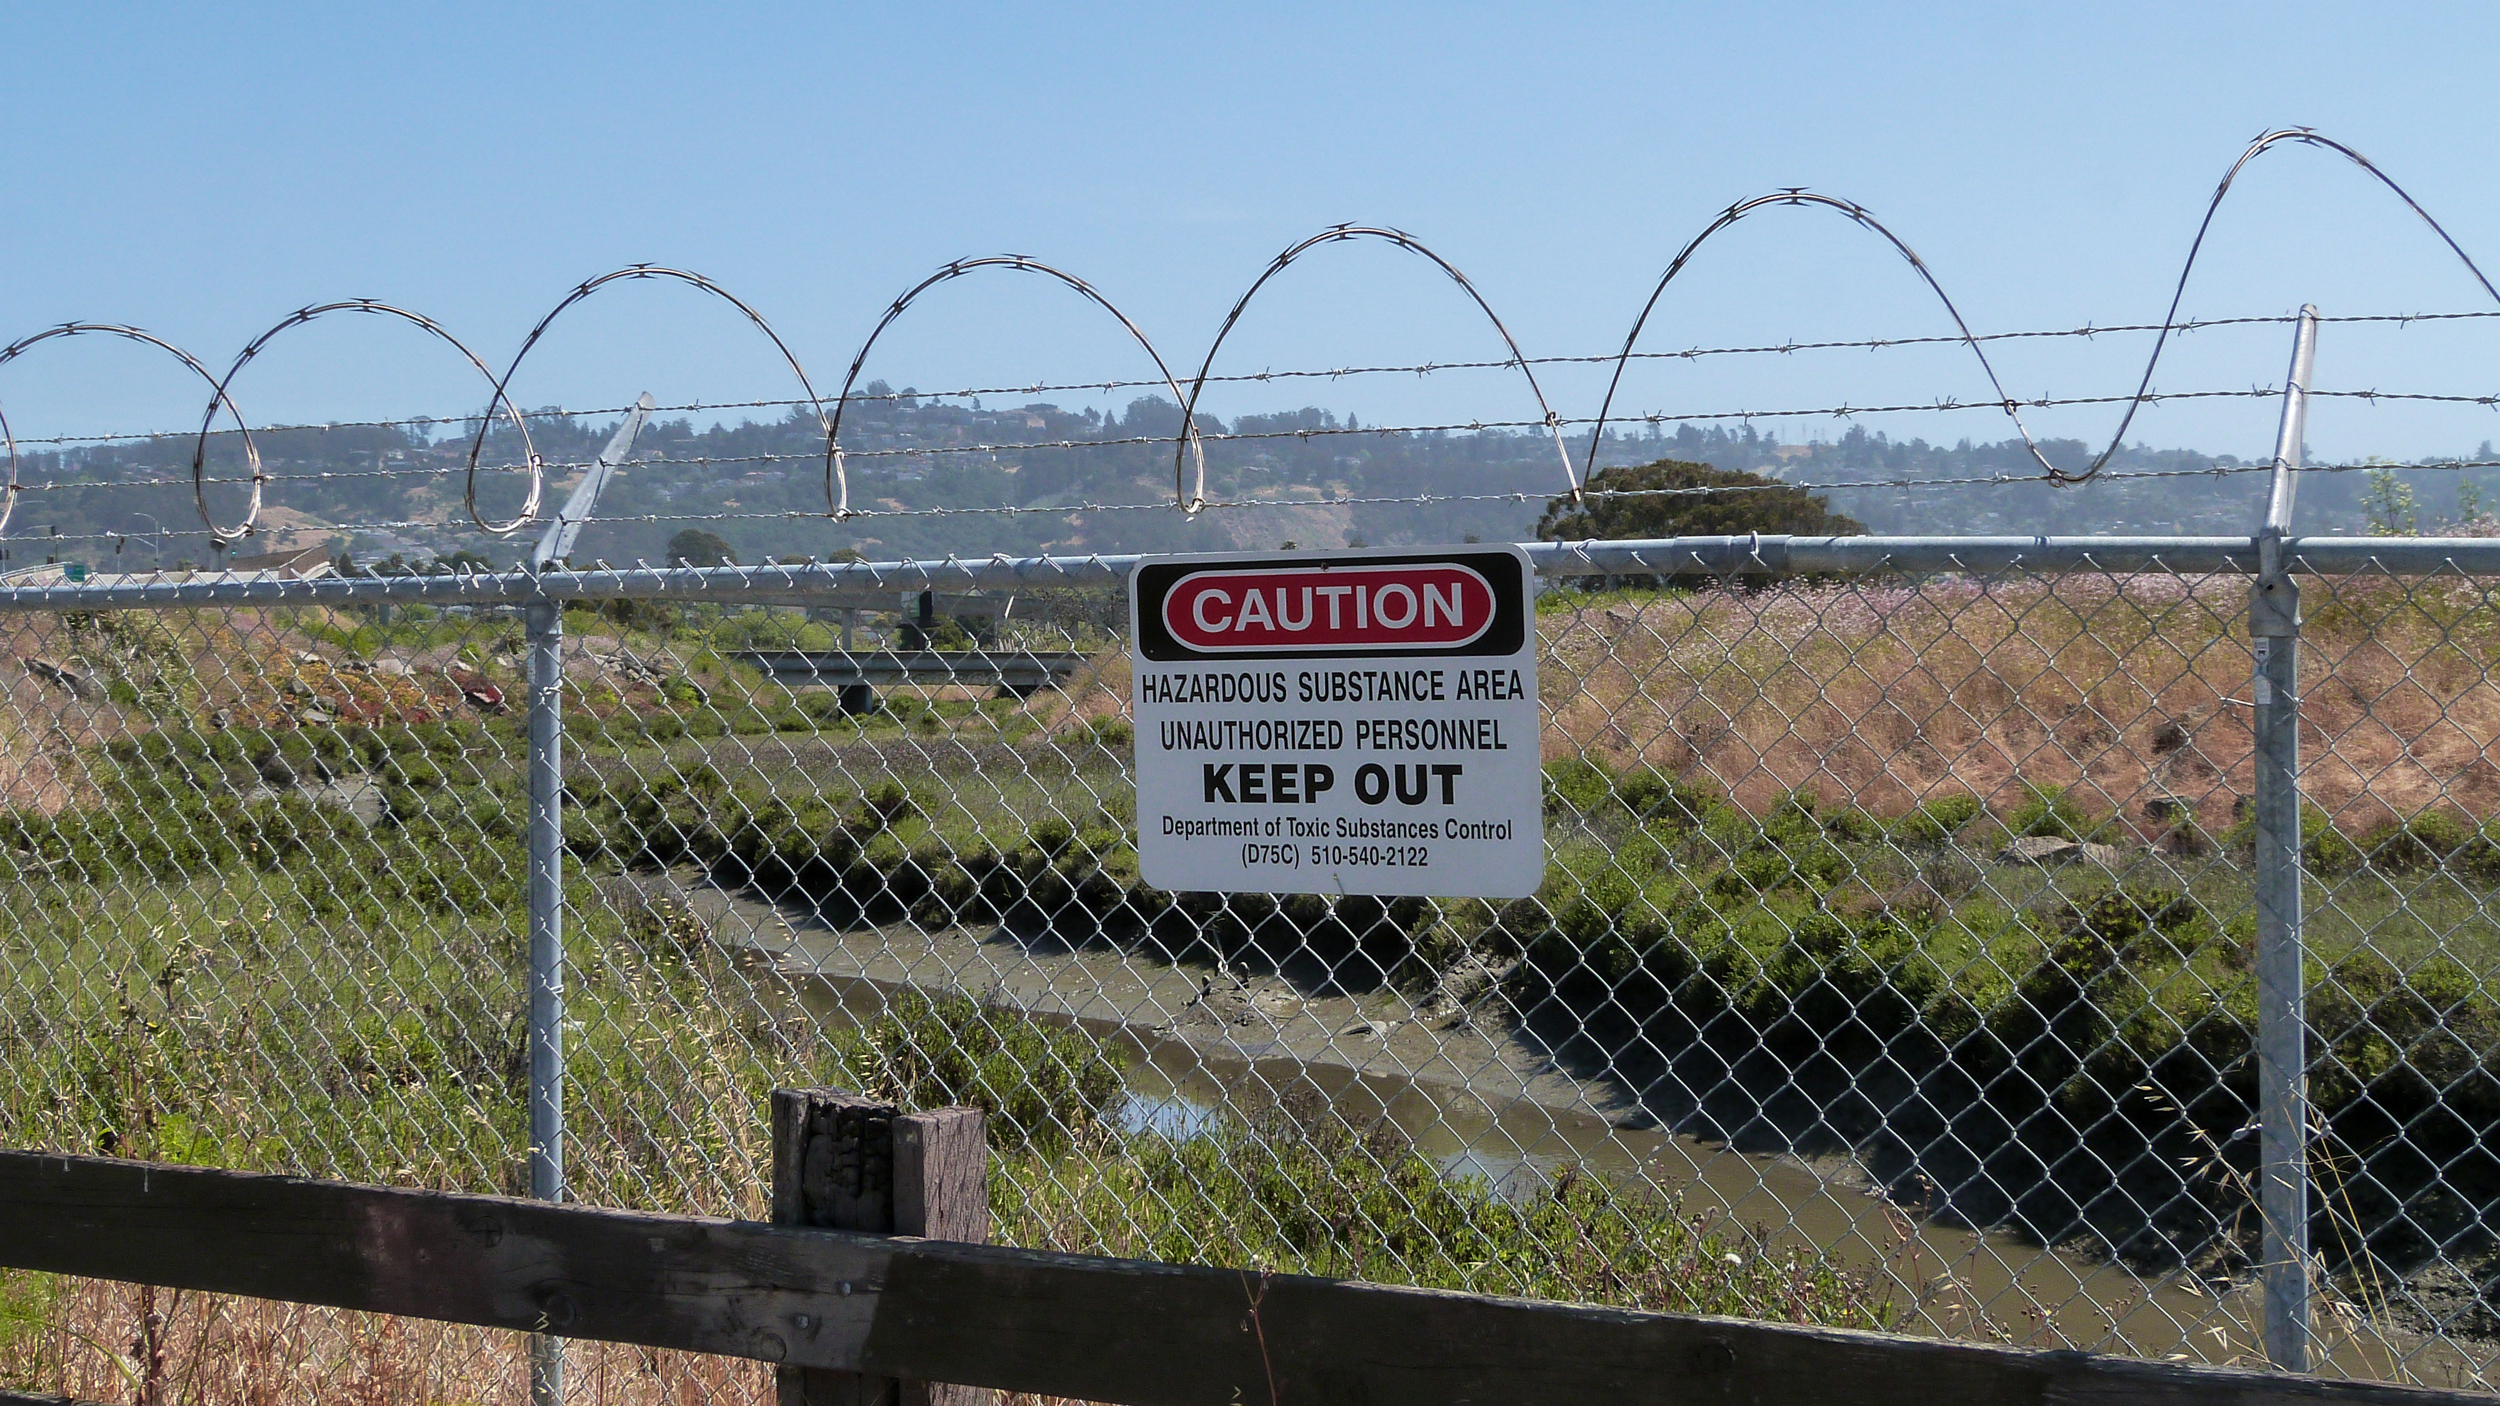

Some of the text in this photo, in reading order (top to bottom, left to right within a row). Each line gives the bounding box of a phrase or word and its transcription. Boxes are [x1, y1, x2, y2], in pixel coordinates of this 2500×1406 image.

[1192, 582, 1463, 633] CAUTION
[1141, 668, 1525, 704] HAZARDOUS SUBSTANCE AREA
[1160, 718, 1508, 751] UNAUTHORIZED PERSONNEL
[1203, 762, 1463, 806] KEEP OUT
[1162, 815, 1512, 842] Department of Toxic Substances Control
[1241, 843, 1429, 870] (D75C) 510-540-2122
